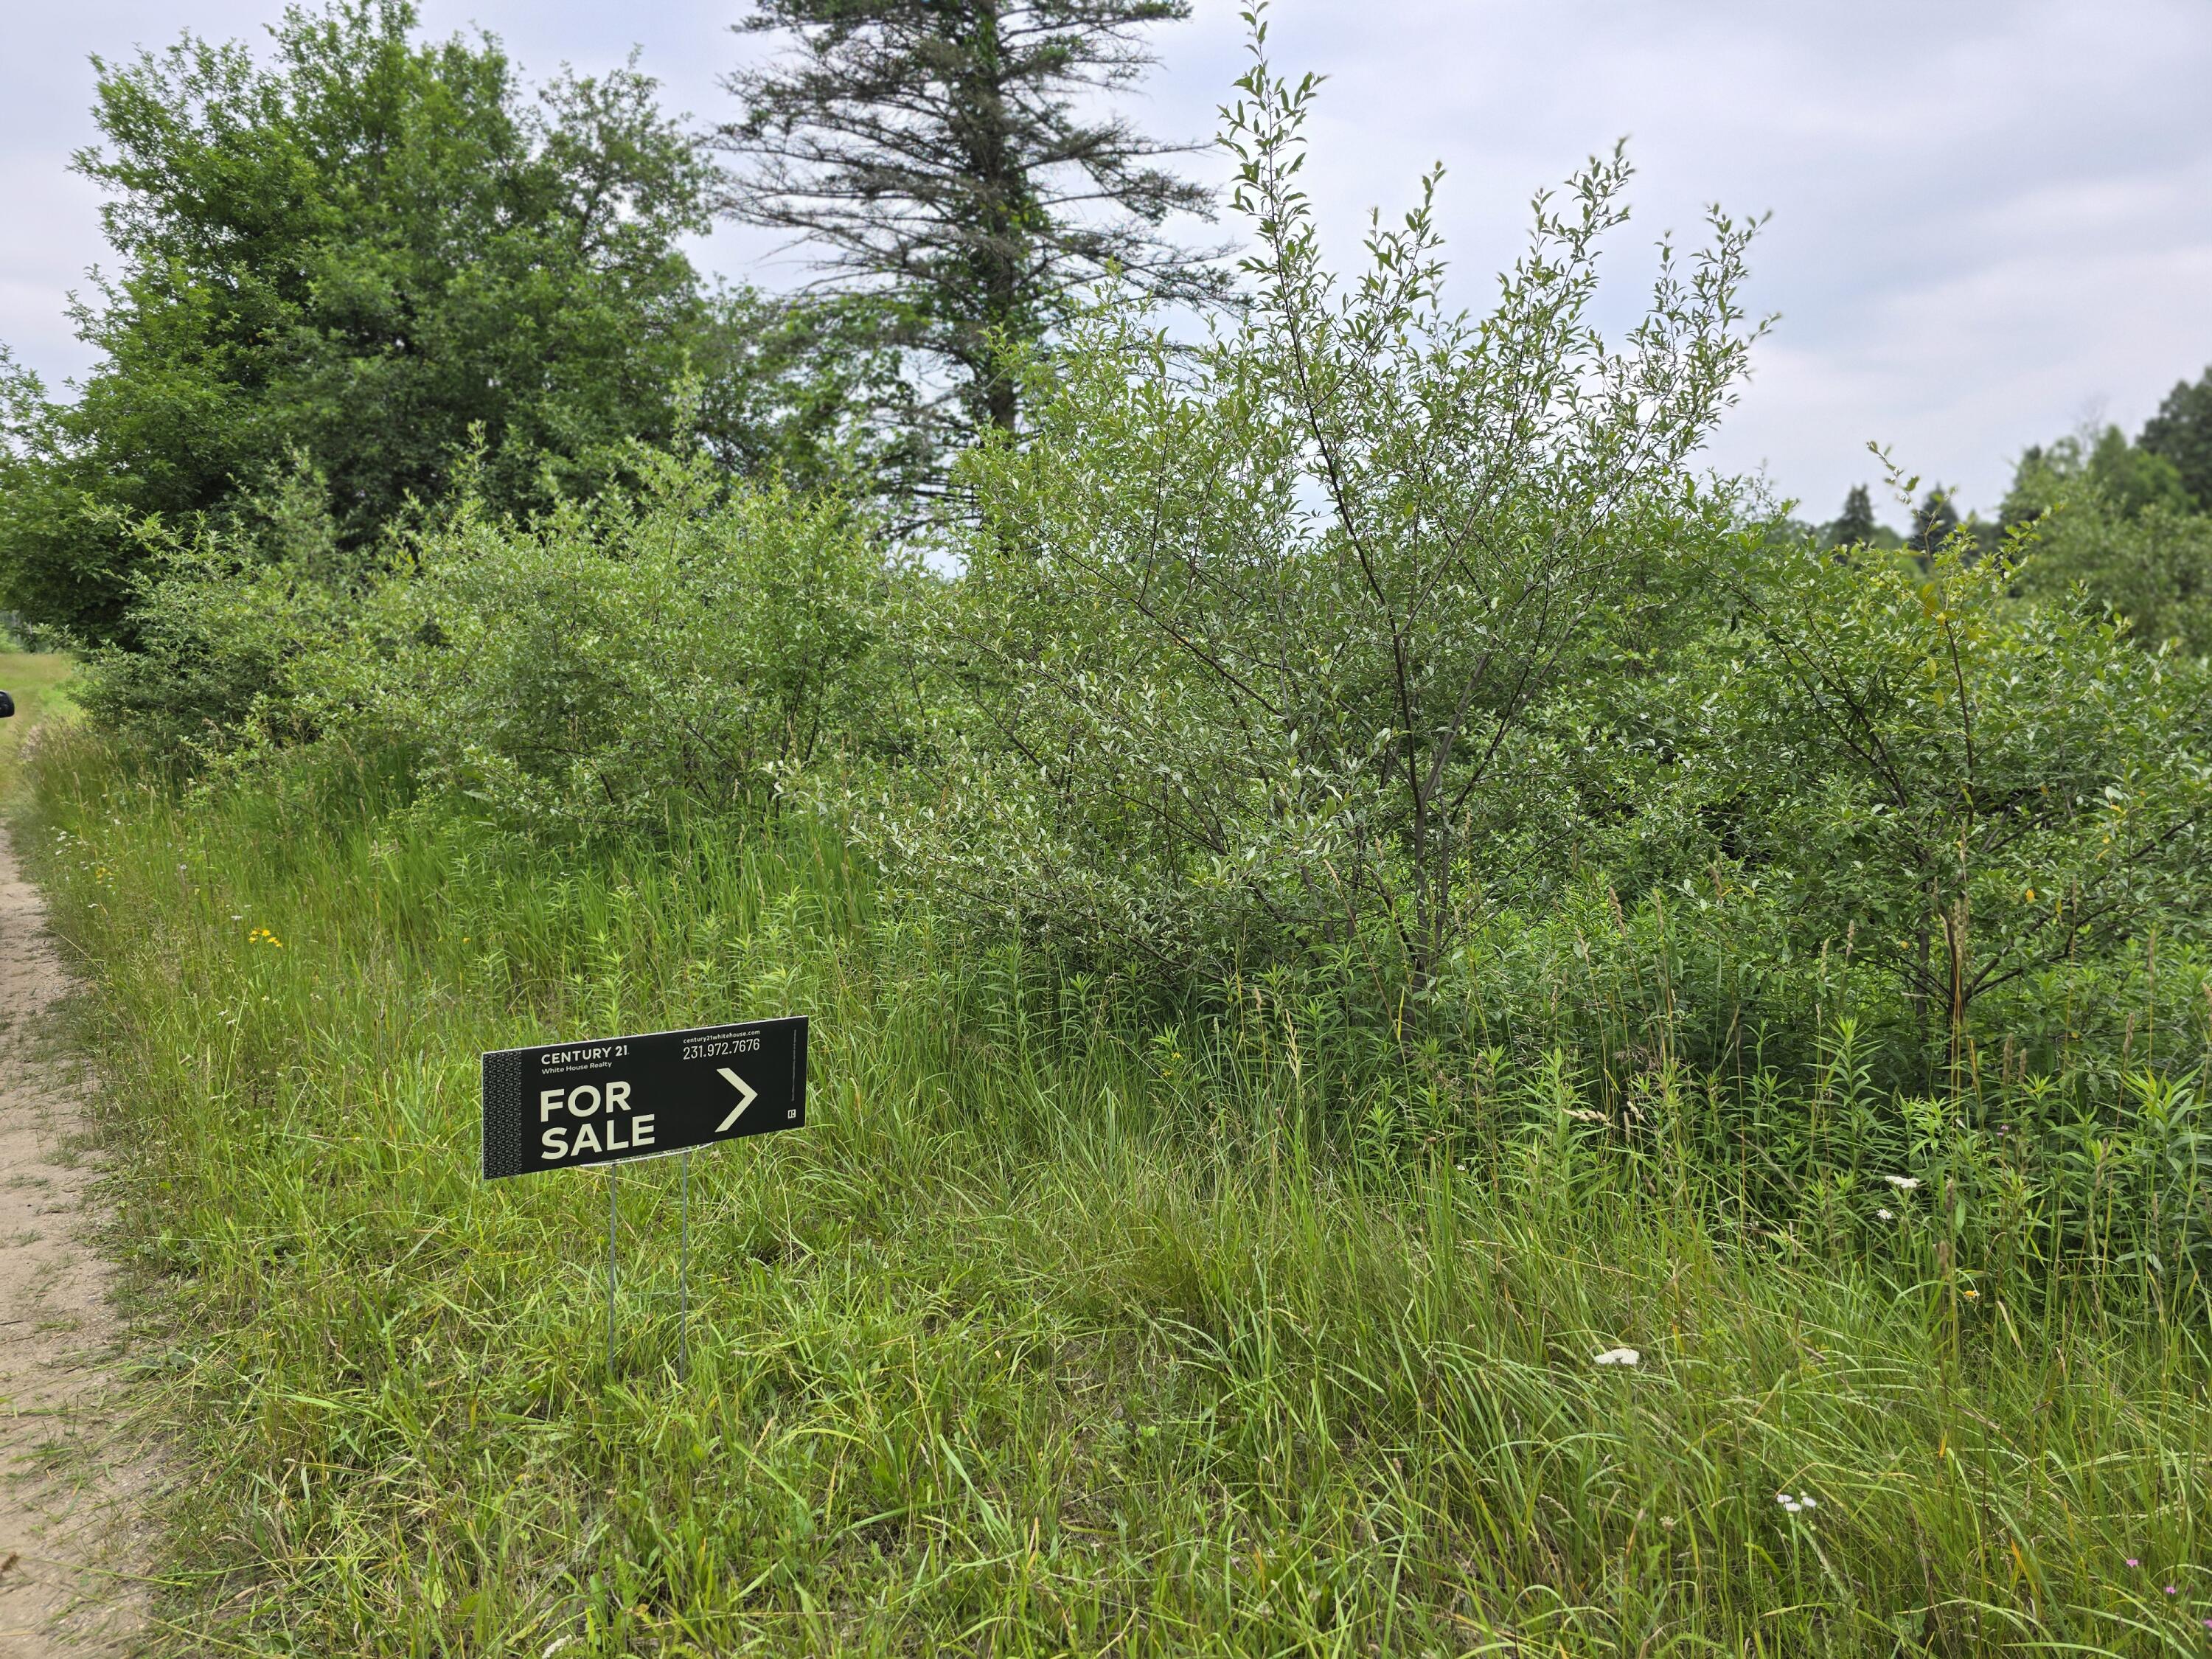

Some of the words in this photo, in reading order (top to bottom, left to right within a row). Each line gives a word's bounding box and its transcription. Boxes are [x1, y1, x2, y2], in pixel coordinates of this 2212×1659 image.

[683, 1030, 760, 1044] century21whitehouse.com
[540, 1046, 612, 1065] CENTURY
[615, 1045, 627, 1057] 21
[683, 1038, 760, 1060] 231.972.7676
[540, 1081, 632, 1122] FOR
[540, 1113, 655, 1160] SALE
